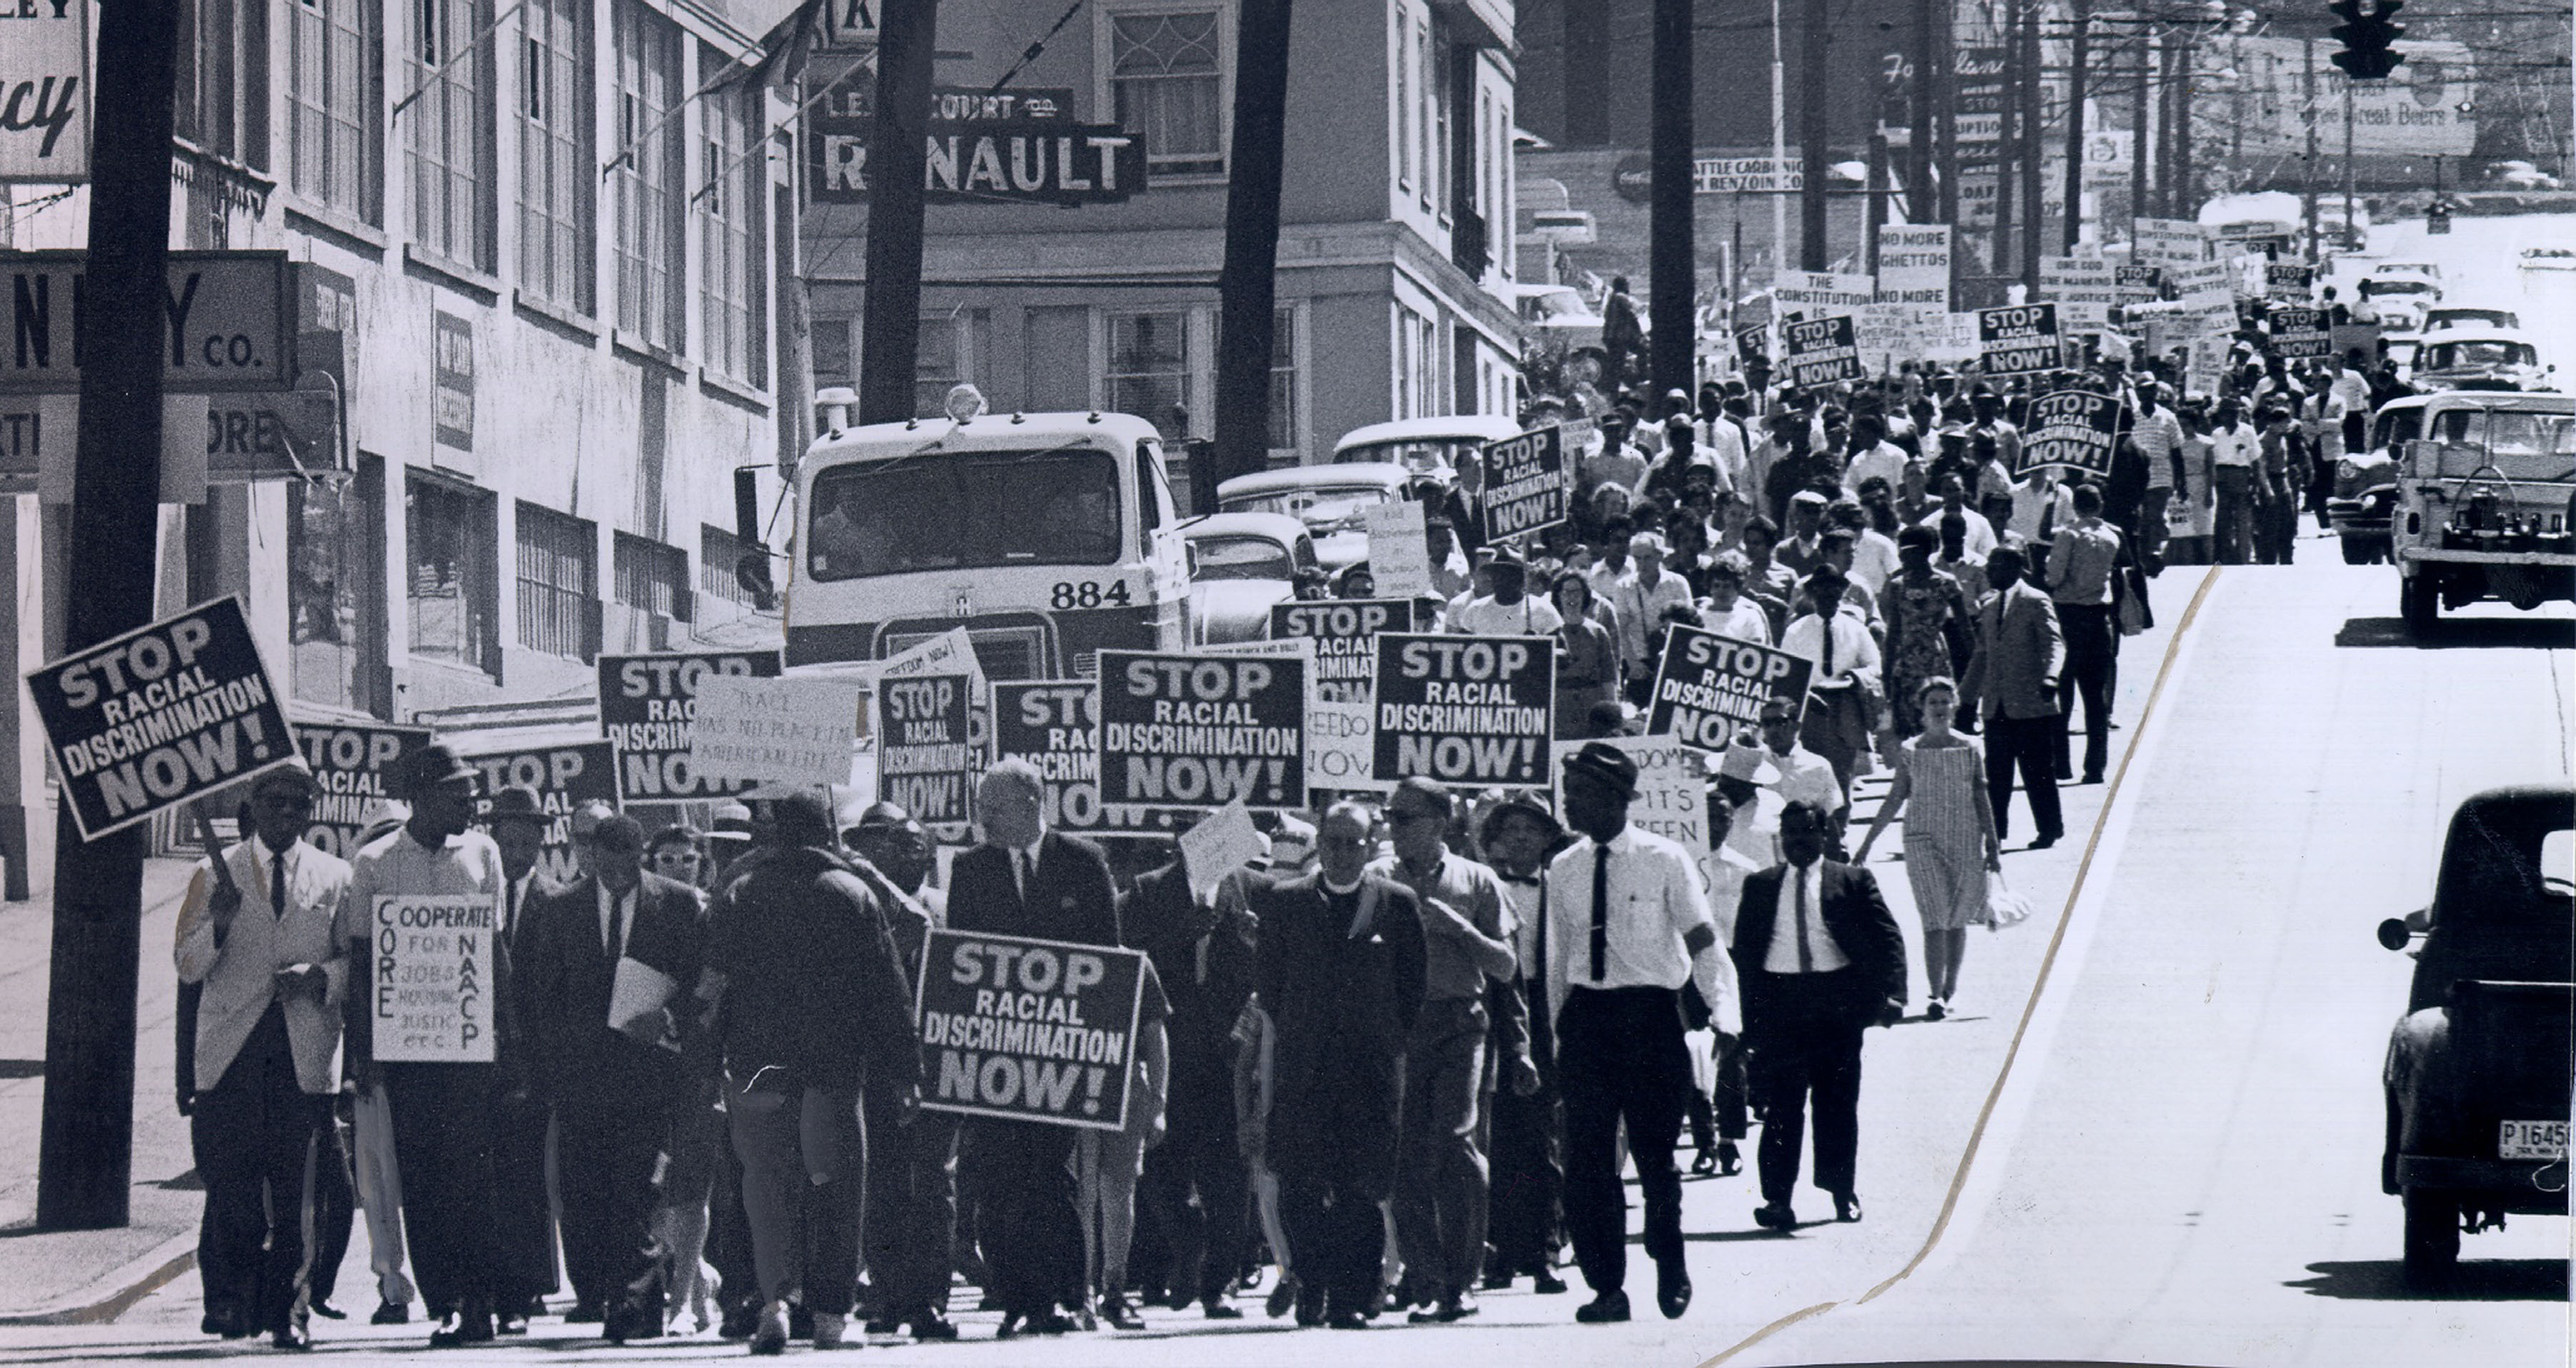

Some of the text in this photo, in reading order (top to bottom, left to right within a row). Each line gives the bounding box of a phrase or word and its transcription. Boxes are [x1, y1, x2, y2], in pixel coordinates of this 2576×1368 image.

[0, 76, 79, 158] cy
[1957, 121, 2002, 135] UPTIO
[2351, 104, 2392, 126] reat
[824, 134, 1132, 192] RNAULT
[1903, 232, 1946, 245] MORE
[1879, 253, 1948, 267] GHETTOS
[2117, 268, 2154, 280] STOP
[2272, 266, 2306, 278] STOP
[1776, 289, 1871, 305] CONSTITUTION
[1807, 275, 1834, 289] THE
[1902, 290, 1944, 303] MORE
[1793, 320, 1841, 342] STOP
[1985, 307, 2044, 329] STOP
[1997, 326, 2039, 338] RACIAL
[2277, 312, 2321, 327] STOP
[204, 333, 263, 368] CO.
[1991, 348, 2055, 372] NOW!
[1798, 360, 1853, 385] NOW!
[2037, 395, 2104, 418] STOP
[2043, 413, 2092, 428] RACIAL
[1492, 433, 1547, 471] STOP
[2027, 440, 2104, 468] NOW!
[1504, 459, 1543, 483] RACIAL
[1495, 491, 1557, 534] NOW!
[1050, 579, 1132, 610] 884
[1287, 605, 1387, 636] STOP
[1318, 636, 1374, 656] ACIAL
[1401, 642, 1529, 681] STOP
[1686, 635, 1791, 683] STOP
[59, 617, 212, 710] STOP
[1127, 659, 1272, 701] STOP
[1426, 681, 1517, 706] RACIAL
[1701, 668, 1773, 702] RACIAL
[102, 666, 217, 727] RACIAL
[648, 699, 695, 722] RAC
[888, 680, 954, 720] STOP
[1019, 687, 1096, 727] ST
[1155, 699, 1259, 725] RACIAL
[1661, 678, 1764, 723] DISCRIMINA
[62, 673, 268, 777] DISCRIMINATION
[904, 719, 950, 744] RACIAL
[1381, 703, 1547, 736] DISCRIMINATION
[295, 731, 401, 770] TOP
[1048, 727, 1097, 751] RAC
[1106, 722, 1298, 756] DISCRIMINATION
[96, 711, 270, 819] NOW!
[478, 751, 584, 791] TOP
[883, 742, 966, 775] DISCRIMINATION
[1398, 735, 1537, 779] NOW!
[317, 770, 387, 795] ACIAL
[1127, 756, 1286, 802] NOW!
[891, 774, 960, 822] NOW!
[1645, 784, 1694, 812] IT'S
[377, 900, 397, 1019] CORE
[408, 935, 449, 955] FOR
[401, 962, 455, 985] JOBS
[951, 943, 1105, 995] STOP
[457, 933, 481, 1050] NAACP
[974, 989, 1085, 1026] RACIAL
[924, 1011, 1124, 1065] DISCRIMINATION
[938, 1050, 1107, 1115] NOW!
